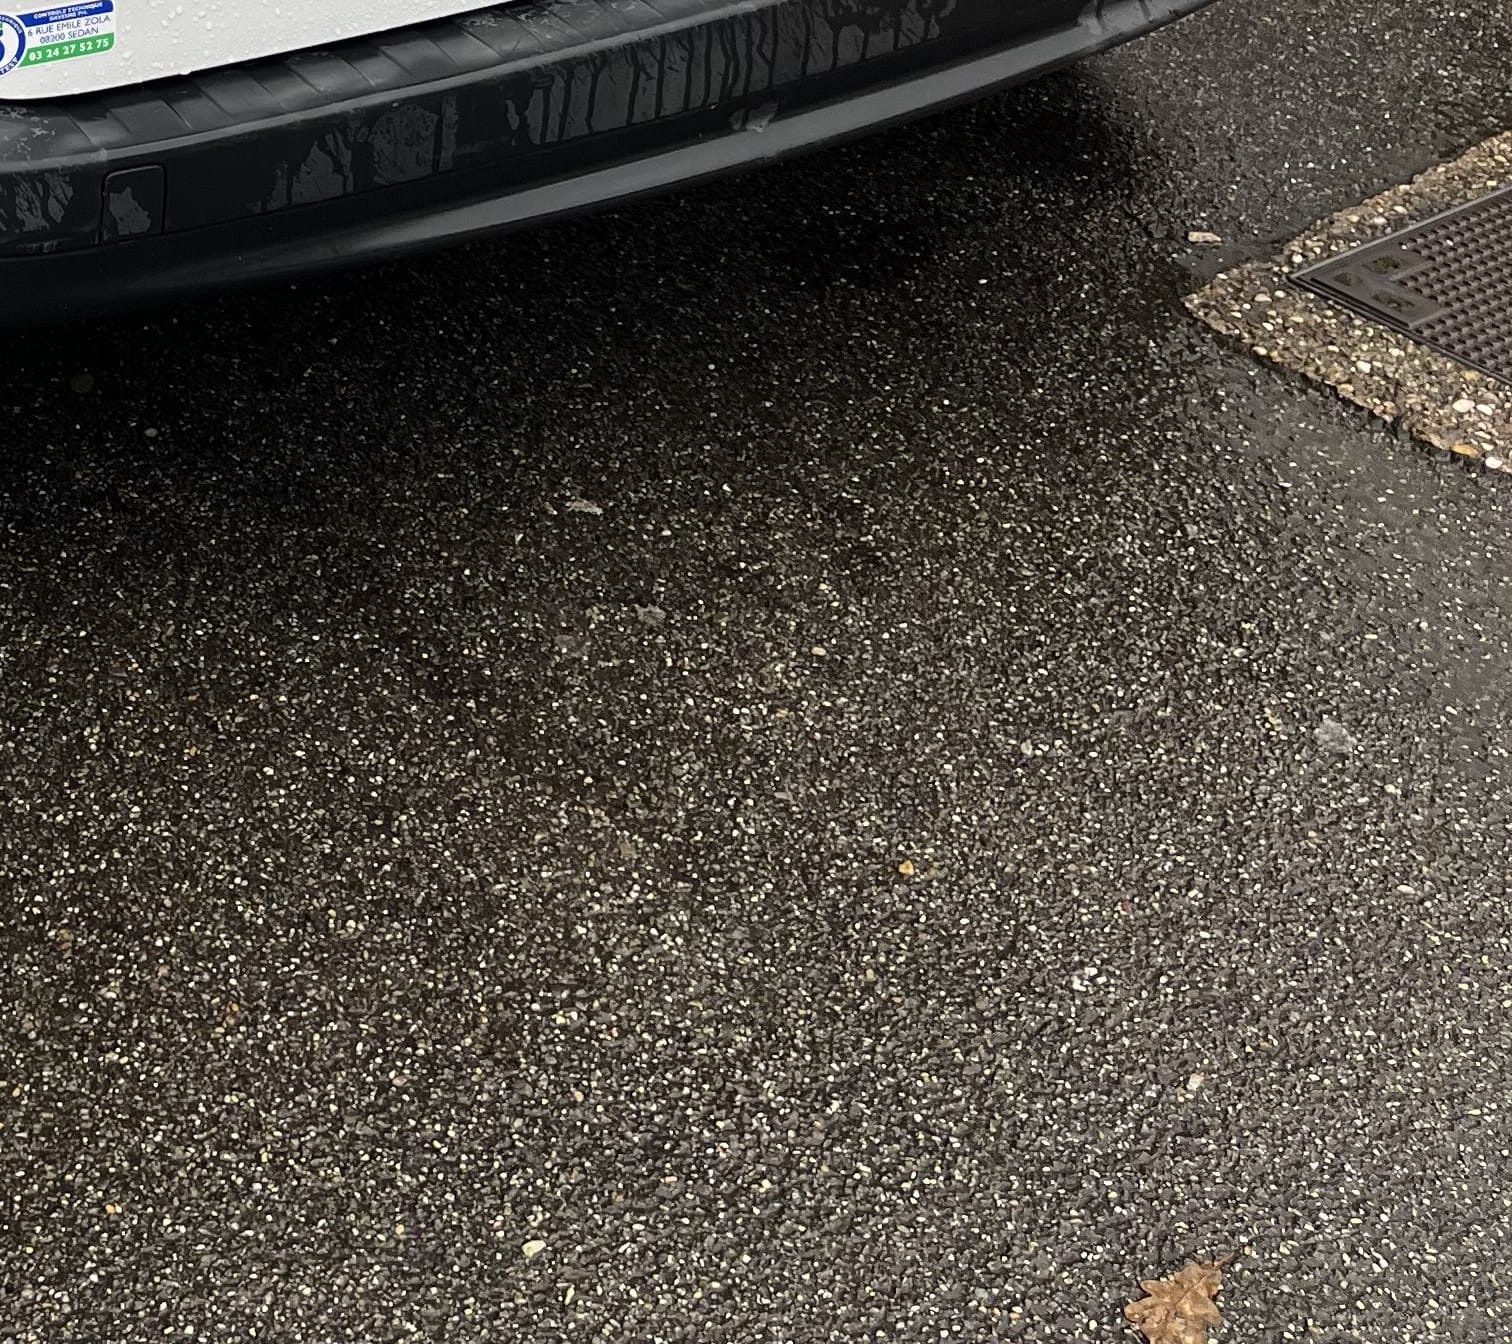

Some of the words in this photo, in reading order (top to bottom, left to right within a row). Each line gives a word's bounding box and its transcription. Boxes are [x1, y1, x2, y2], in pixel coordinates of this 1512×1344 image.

[27, 28, 34, 37] 6
[35, 25, 55, 35] RUE
[84, 15, 112, 27] ZOLA
[68, 26, 99, 40] SEDAN
[28, 50, 43, 61] 03
[45, 47, 60, 58] 24
[62, 44, 76, 55] 27
[79, 41, 94, 52] 52
[95, 38, 110, 49] 75
